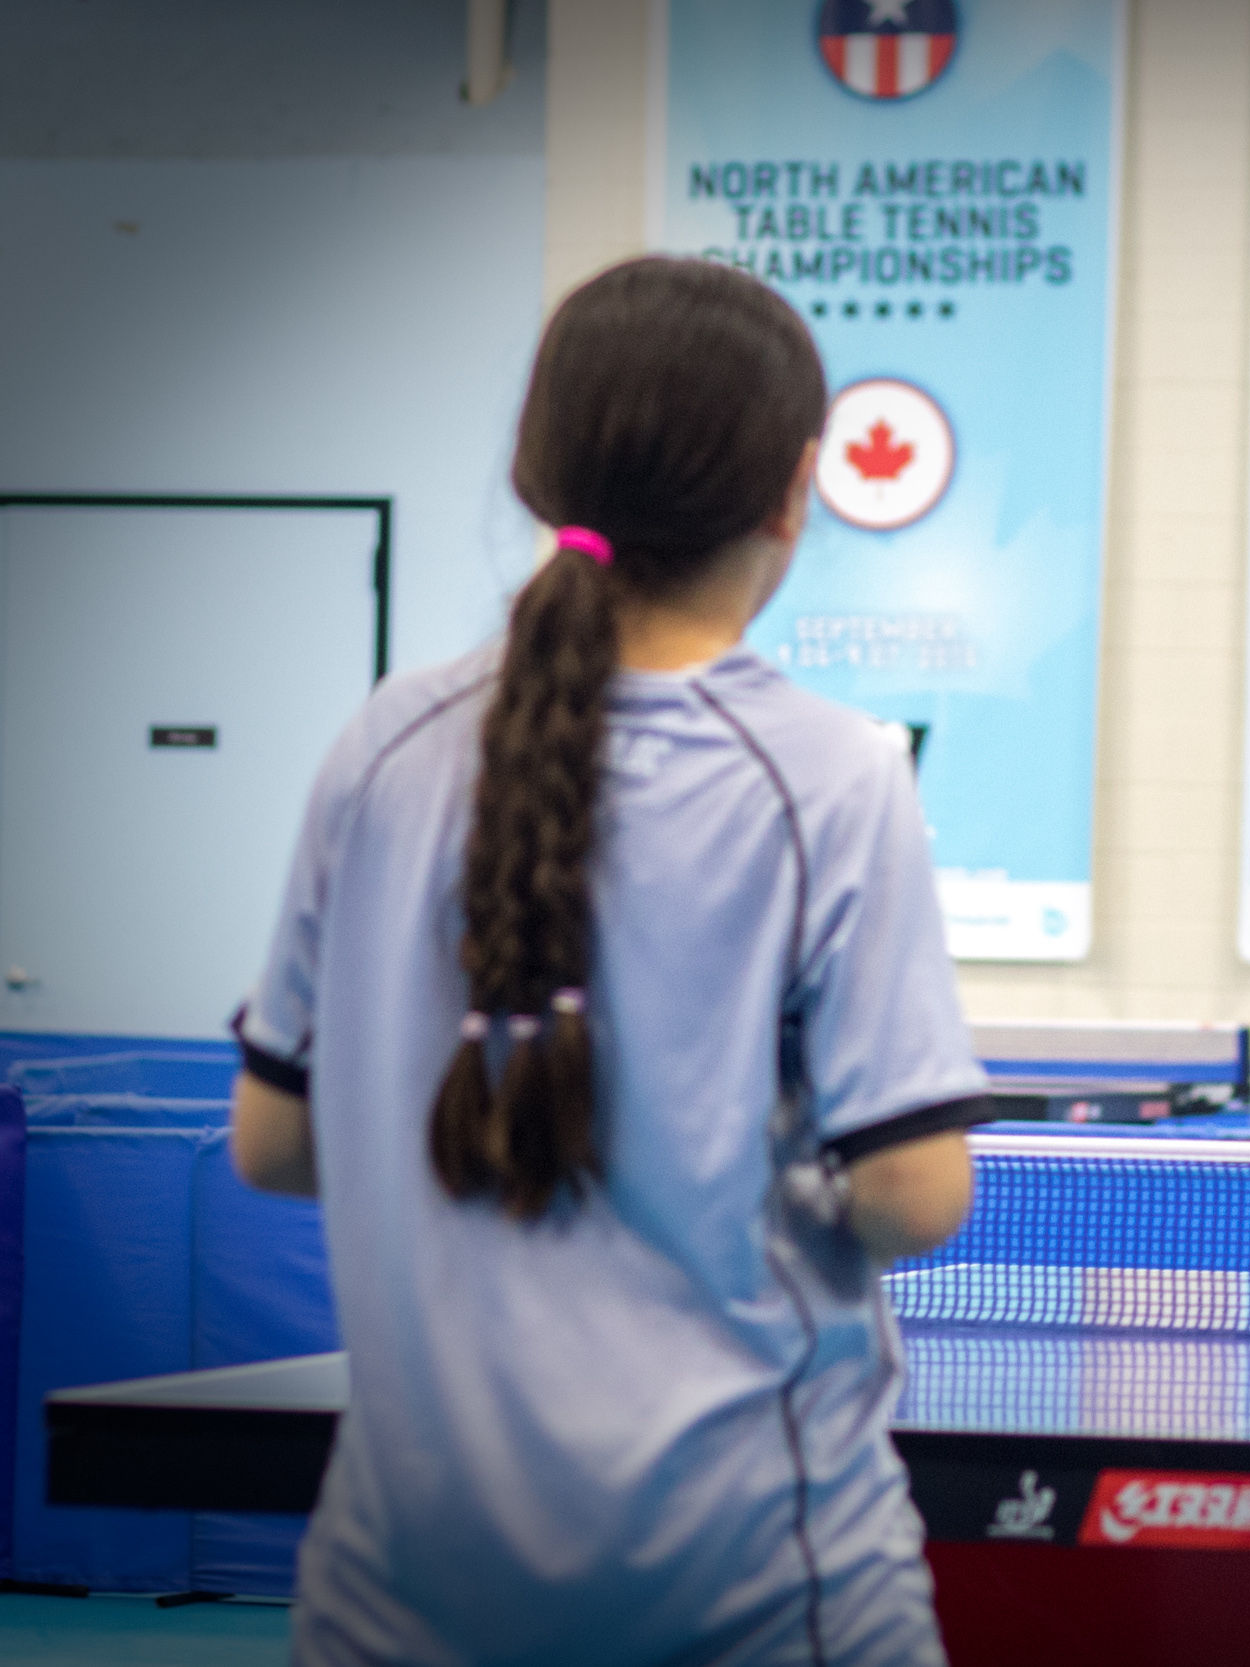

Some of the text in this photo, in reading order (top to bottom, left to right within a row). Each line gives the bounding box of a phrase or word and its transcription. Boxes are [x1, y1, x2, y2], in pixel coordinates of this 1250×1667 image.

[690, 160, 1086, 198] NORTH AMERICAN
[735, 203, 1039, 241] TABLE TENNIS
